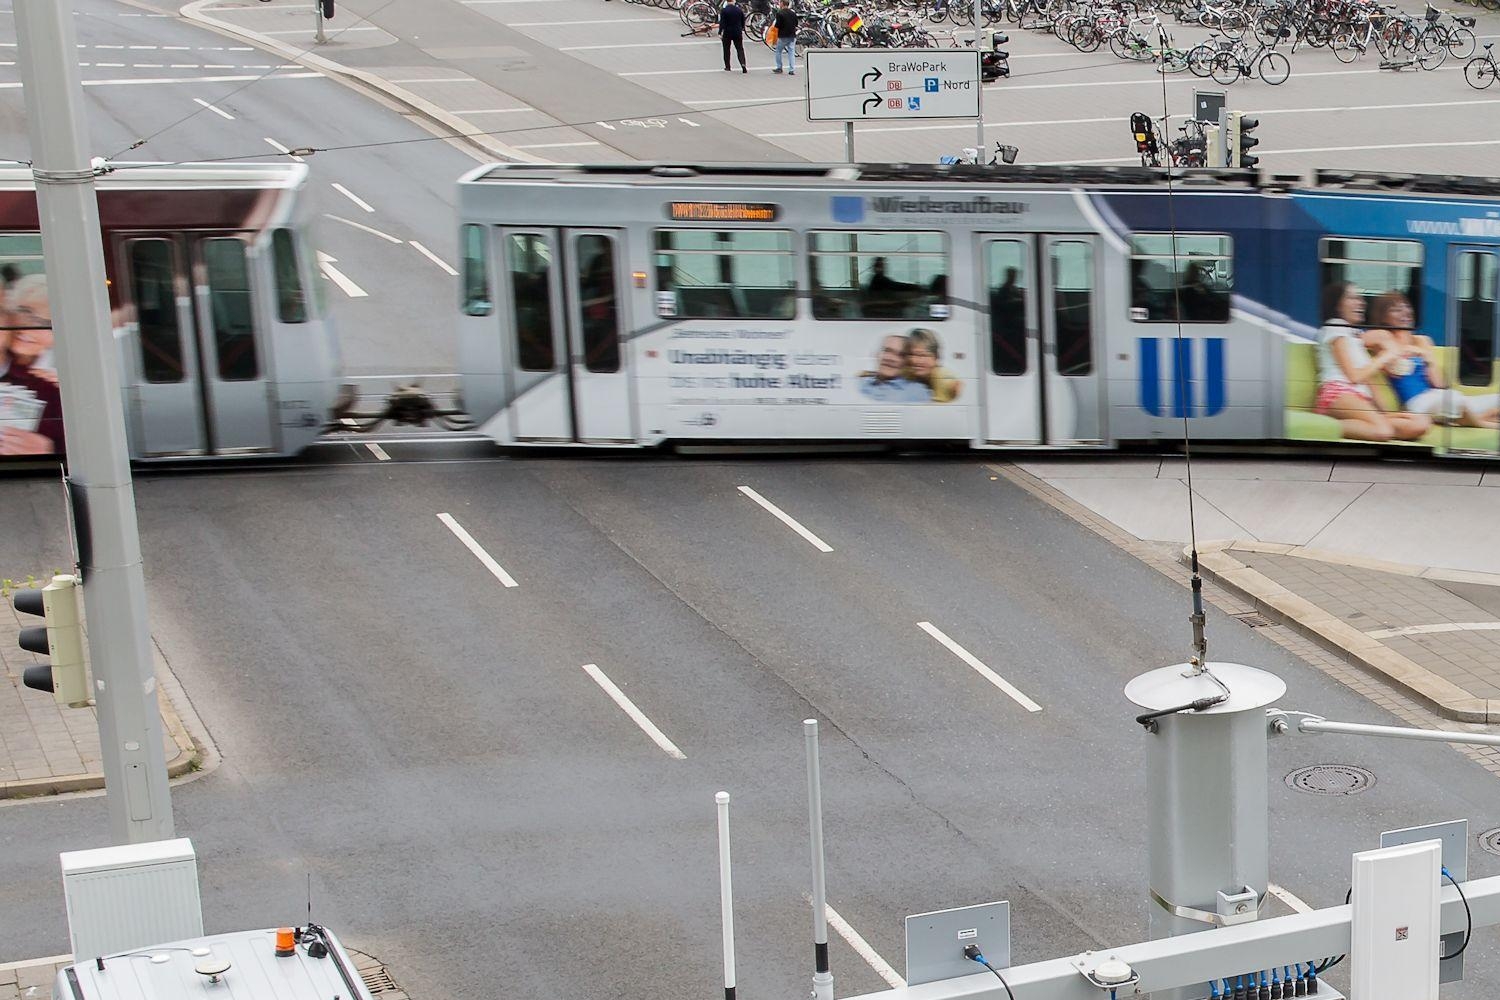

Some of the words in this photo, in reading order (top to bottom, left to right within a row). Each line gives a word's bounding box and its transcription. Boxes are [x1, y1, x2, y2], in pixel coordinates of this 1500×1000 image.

[888, 61, 947, 72] BraWoPark
[888, 81, 901, 90] DB
[944, 80, 970, 90] Nord
[889, 99, 901, 108] DB
